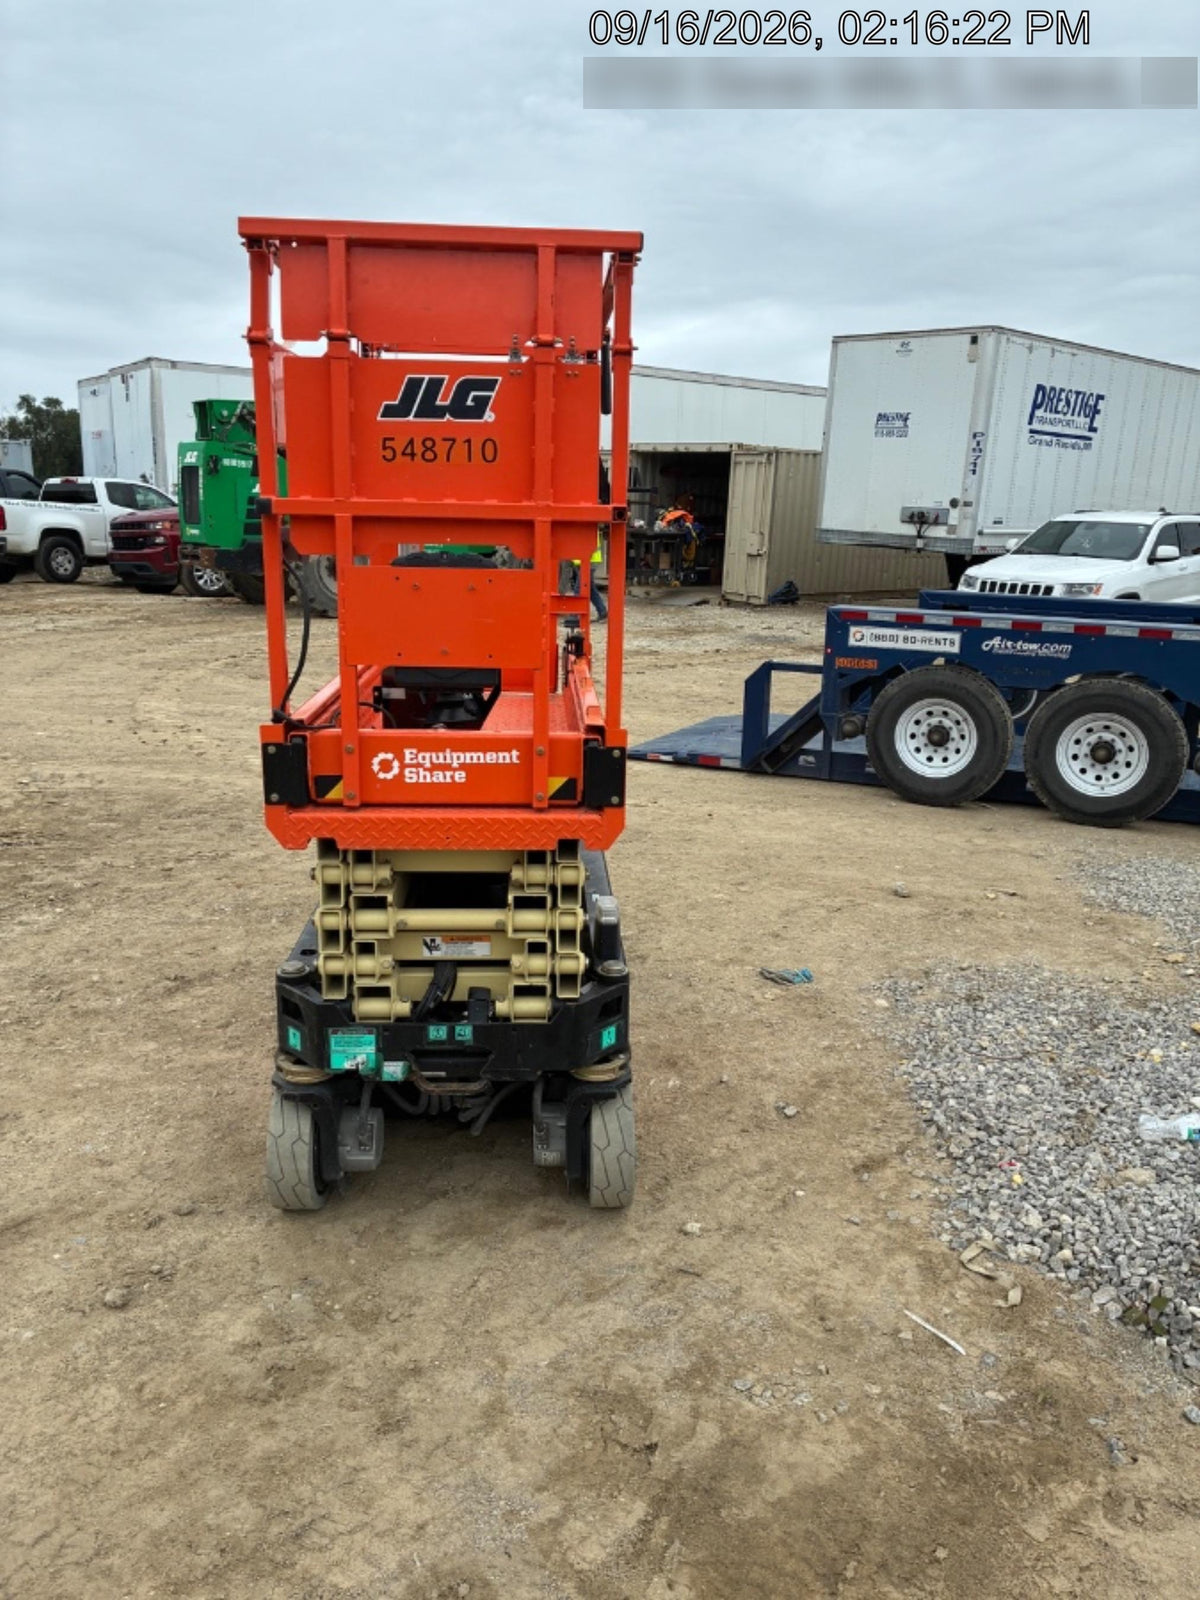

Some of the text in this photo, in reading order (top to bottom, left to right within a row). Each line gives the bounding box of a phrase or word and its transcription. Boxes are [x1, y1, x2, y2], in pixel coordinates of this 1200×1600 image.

[377, 375, 502, 422] JLG
[1028, 384, 1105, 433] PRESTIGE
[382, 437, 498, 463] 548710
[404, 748, 520, 768] Equipment
[404, 767, 466, 783] Share
